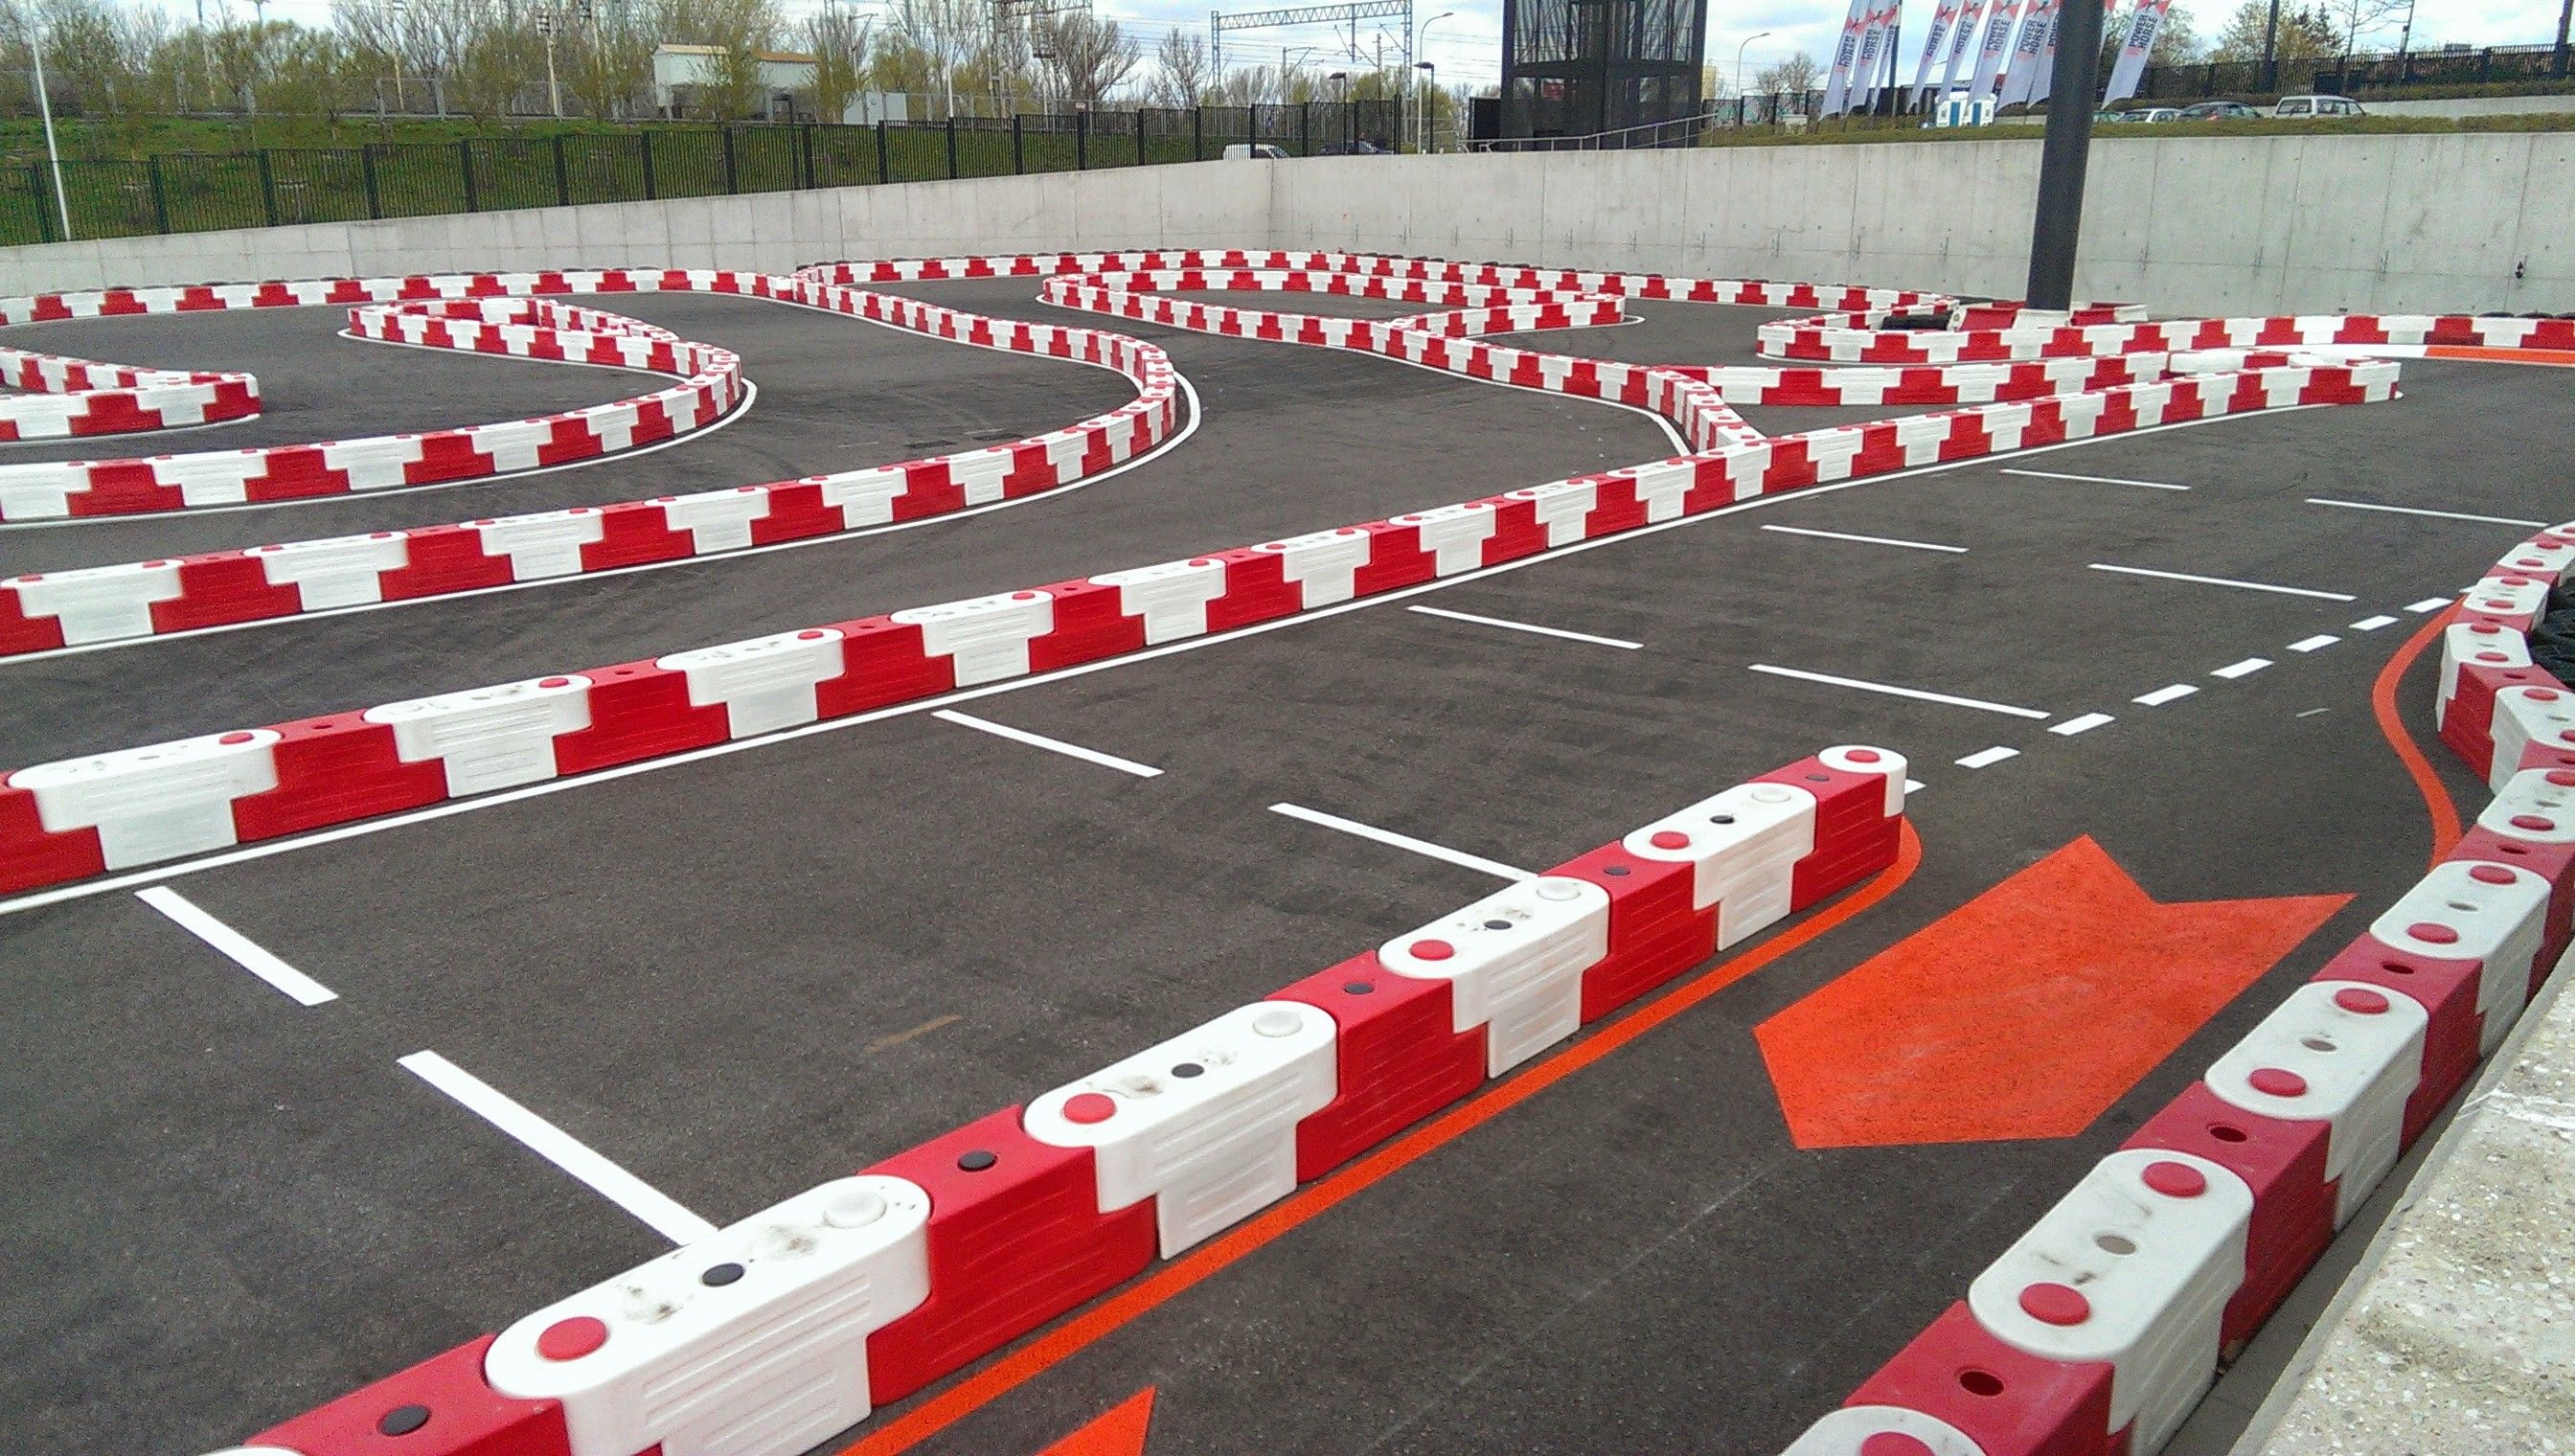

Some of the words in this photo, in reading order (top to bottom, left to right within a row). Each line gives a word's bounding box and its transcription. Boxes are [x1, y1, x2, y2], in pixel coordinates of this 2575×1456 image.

[1986, 18, 2000, 51] POWER
[1993, 20, 2011, 51] HORSE
[2018, 19, 2038, 52] POWER
[2028, 20, 2047, 55] HORSE
[2129, 14, 2149, 47] POWER
[2137, 16, 2158, 49] HORSE
